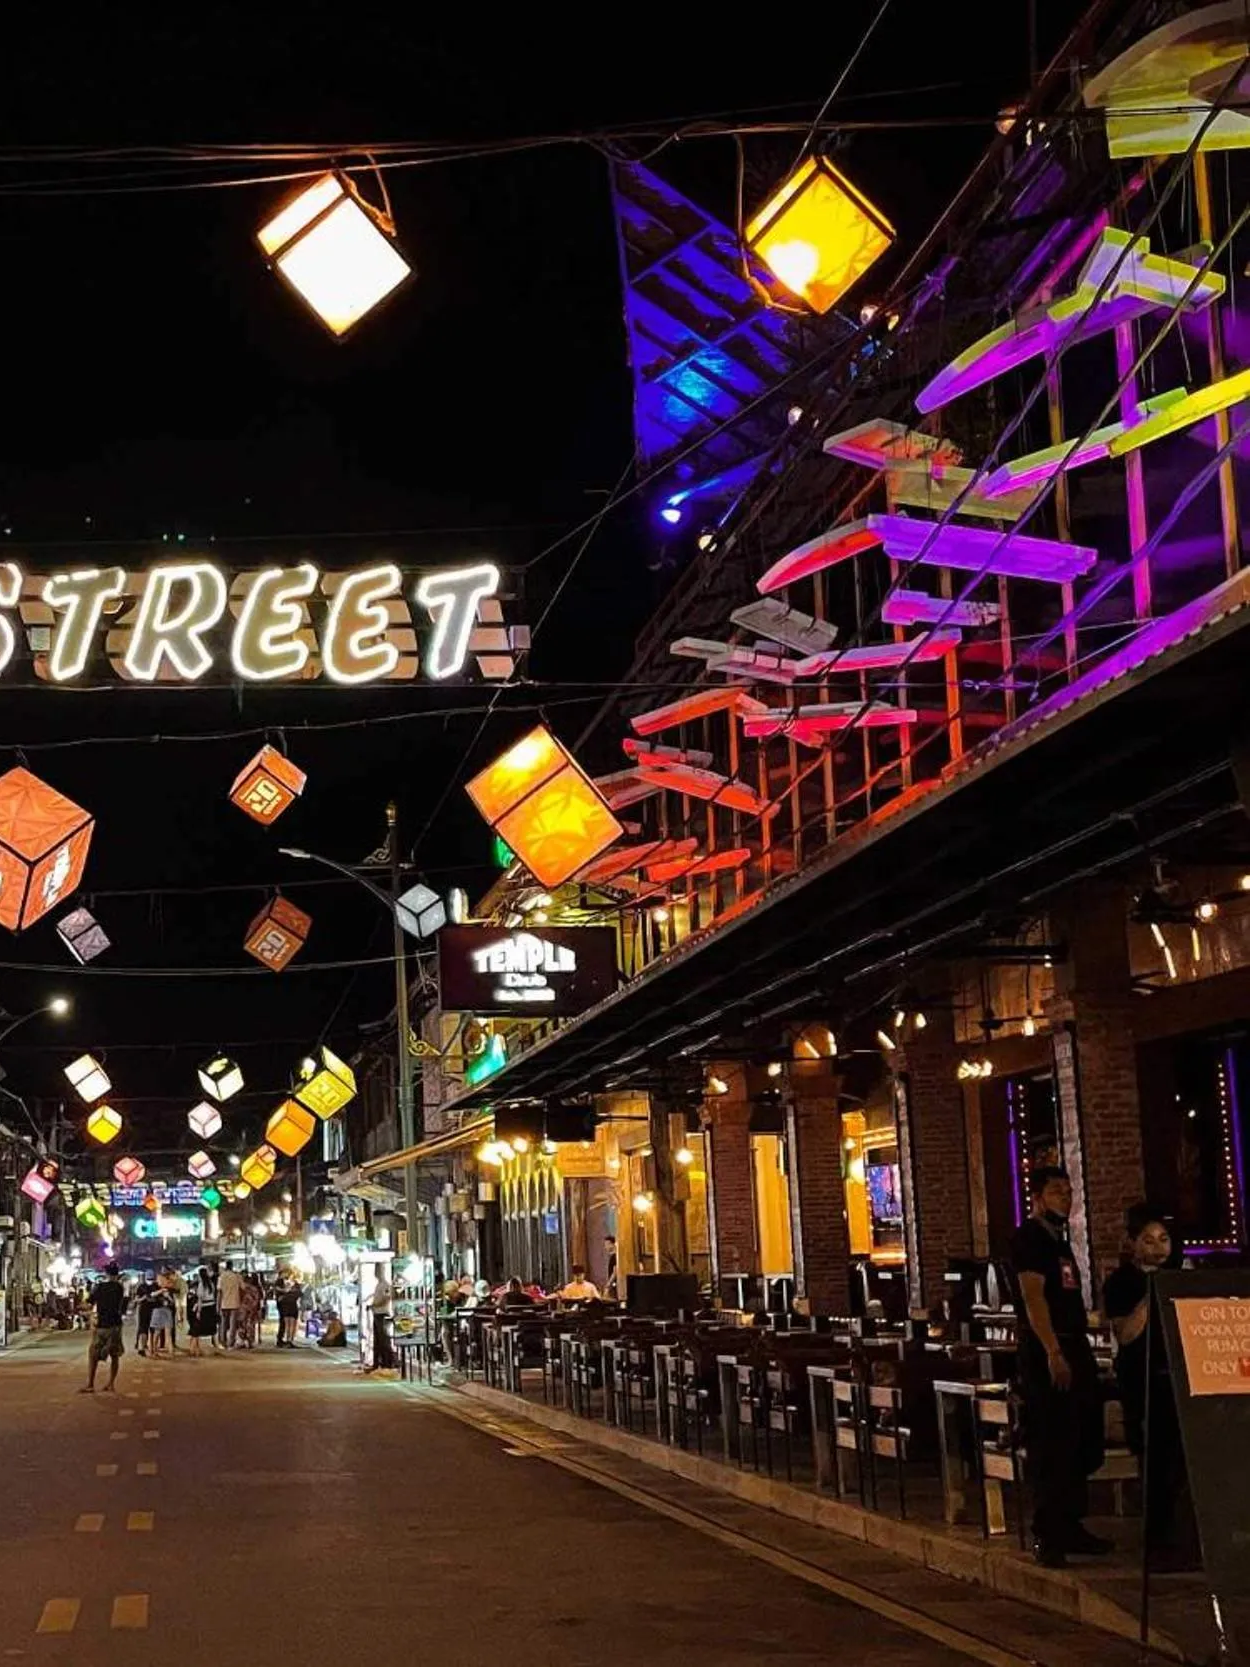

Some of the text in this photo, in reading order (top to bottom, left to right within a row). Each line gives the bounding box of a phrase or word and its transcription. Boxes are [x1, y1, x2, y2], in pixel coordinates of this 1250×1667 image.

[1199, 1305, 1250, 1321] GIN TO
[1190, 1323, 1234, 1338] VODKA
[1207, 1339, 1238, 1353] RUM
[1202, 1360, 1237, 1375] ONLY
